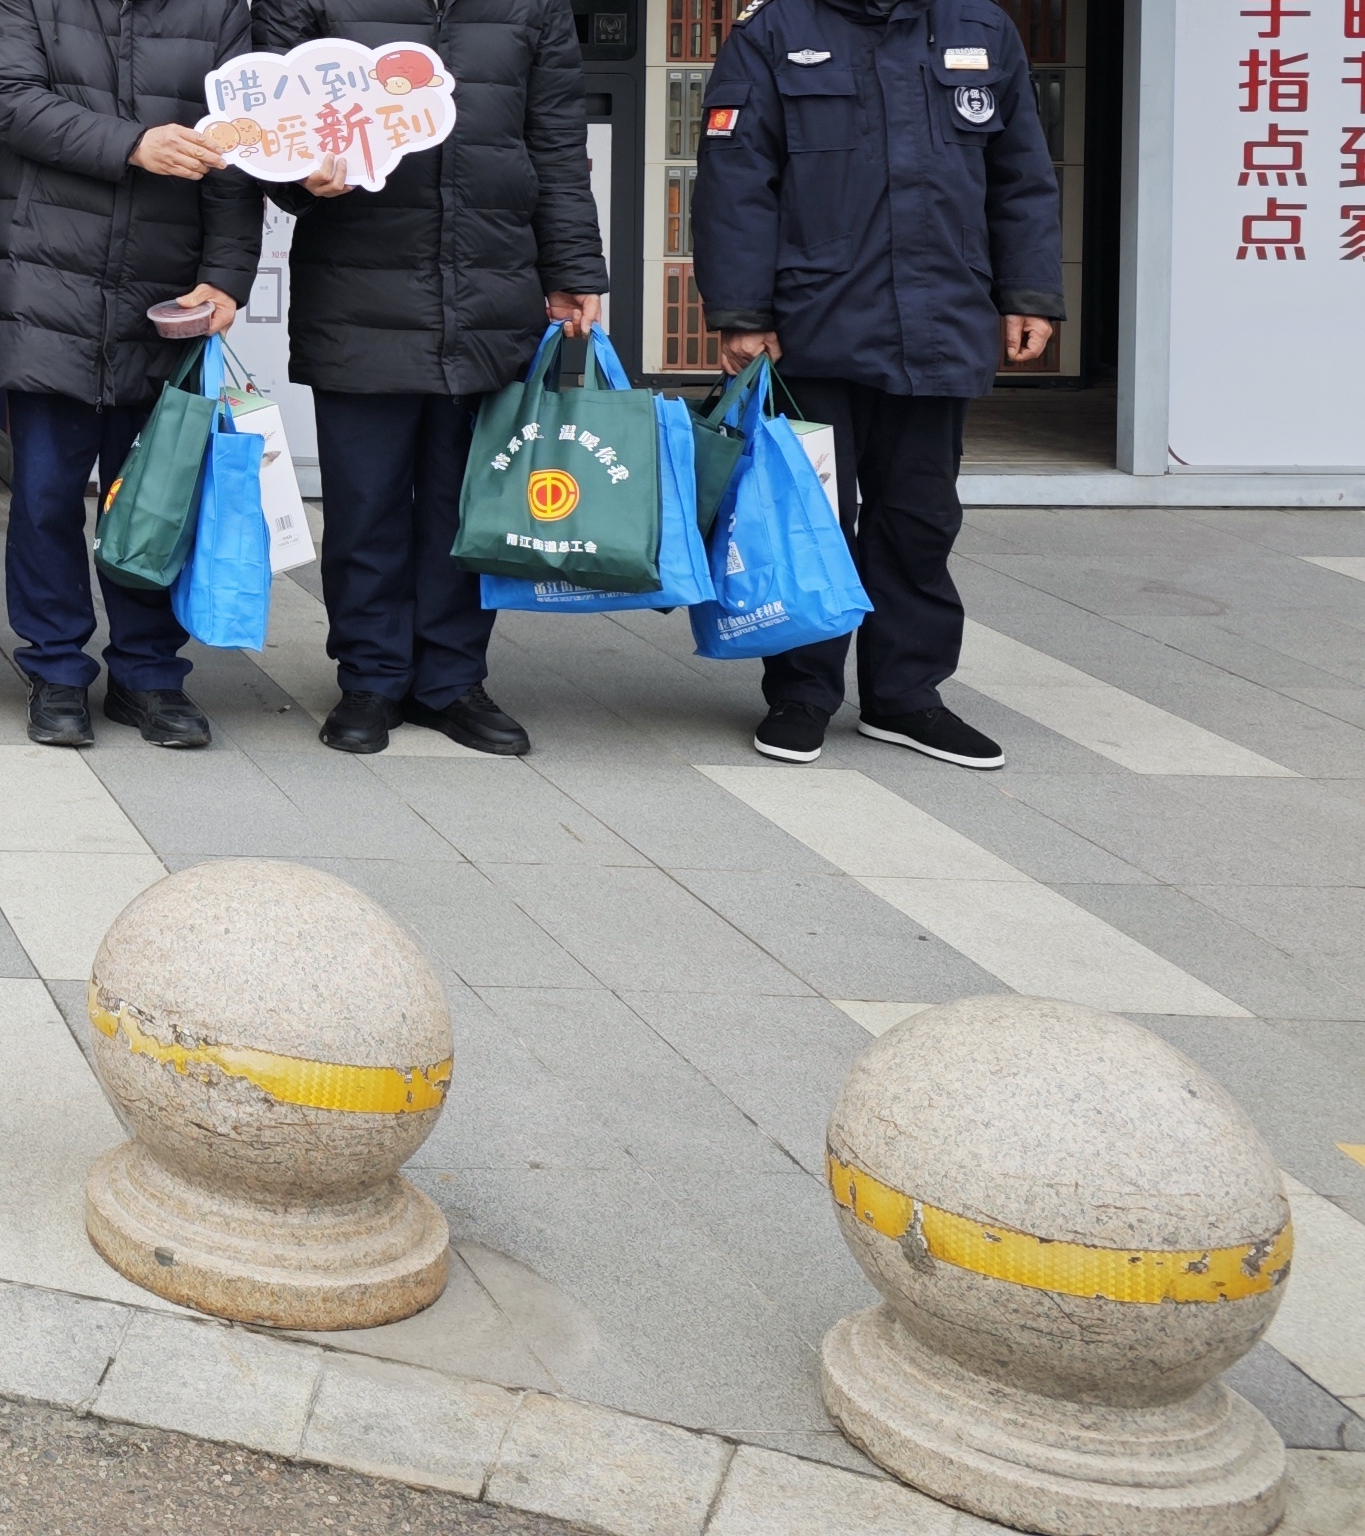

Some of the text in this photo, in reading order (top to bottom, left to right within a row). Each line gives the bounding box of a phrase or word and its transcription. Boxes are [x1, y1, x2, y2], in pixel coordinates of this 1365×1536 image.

[214, 61, 371, 113] 腊八到
[260, 102, 438, 184] 暖新到
